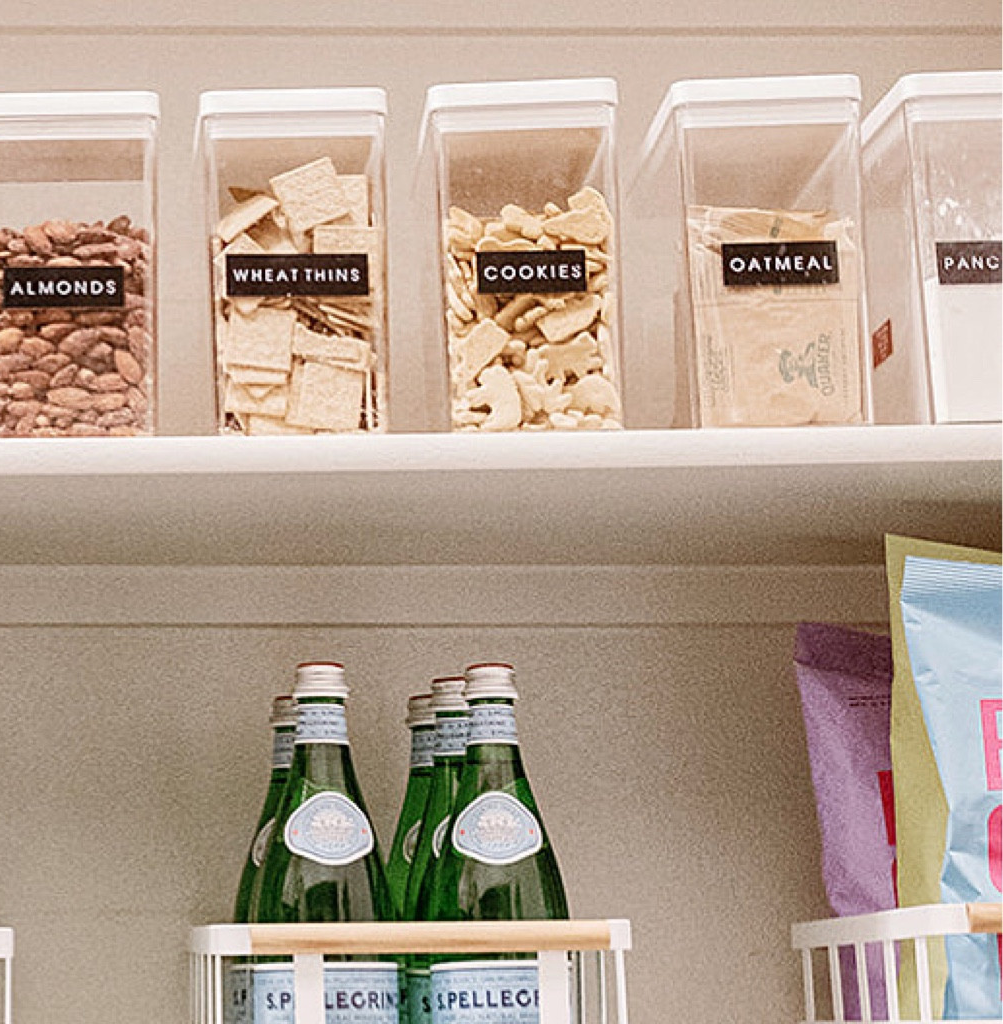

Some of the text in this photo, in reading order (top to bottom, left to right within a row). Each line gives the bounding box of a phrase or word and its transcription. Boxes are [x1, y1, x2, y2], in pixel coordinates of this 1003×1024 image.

[729, 255, 833, 273] OATMEAL
[943, 255, 1001, 271] PANC
[232, 267, 361, 283] WHEAT THINS
[483, 264, 583, 281] COOKIES
[9, 280, 118, 297] ALMONDS
